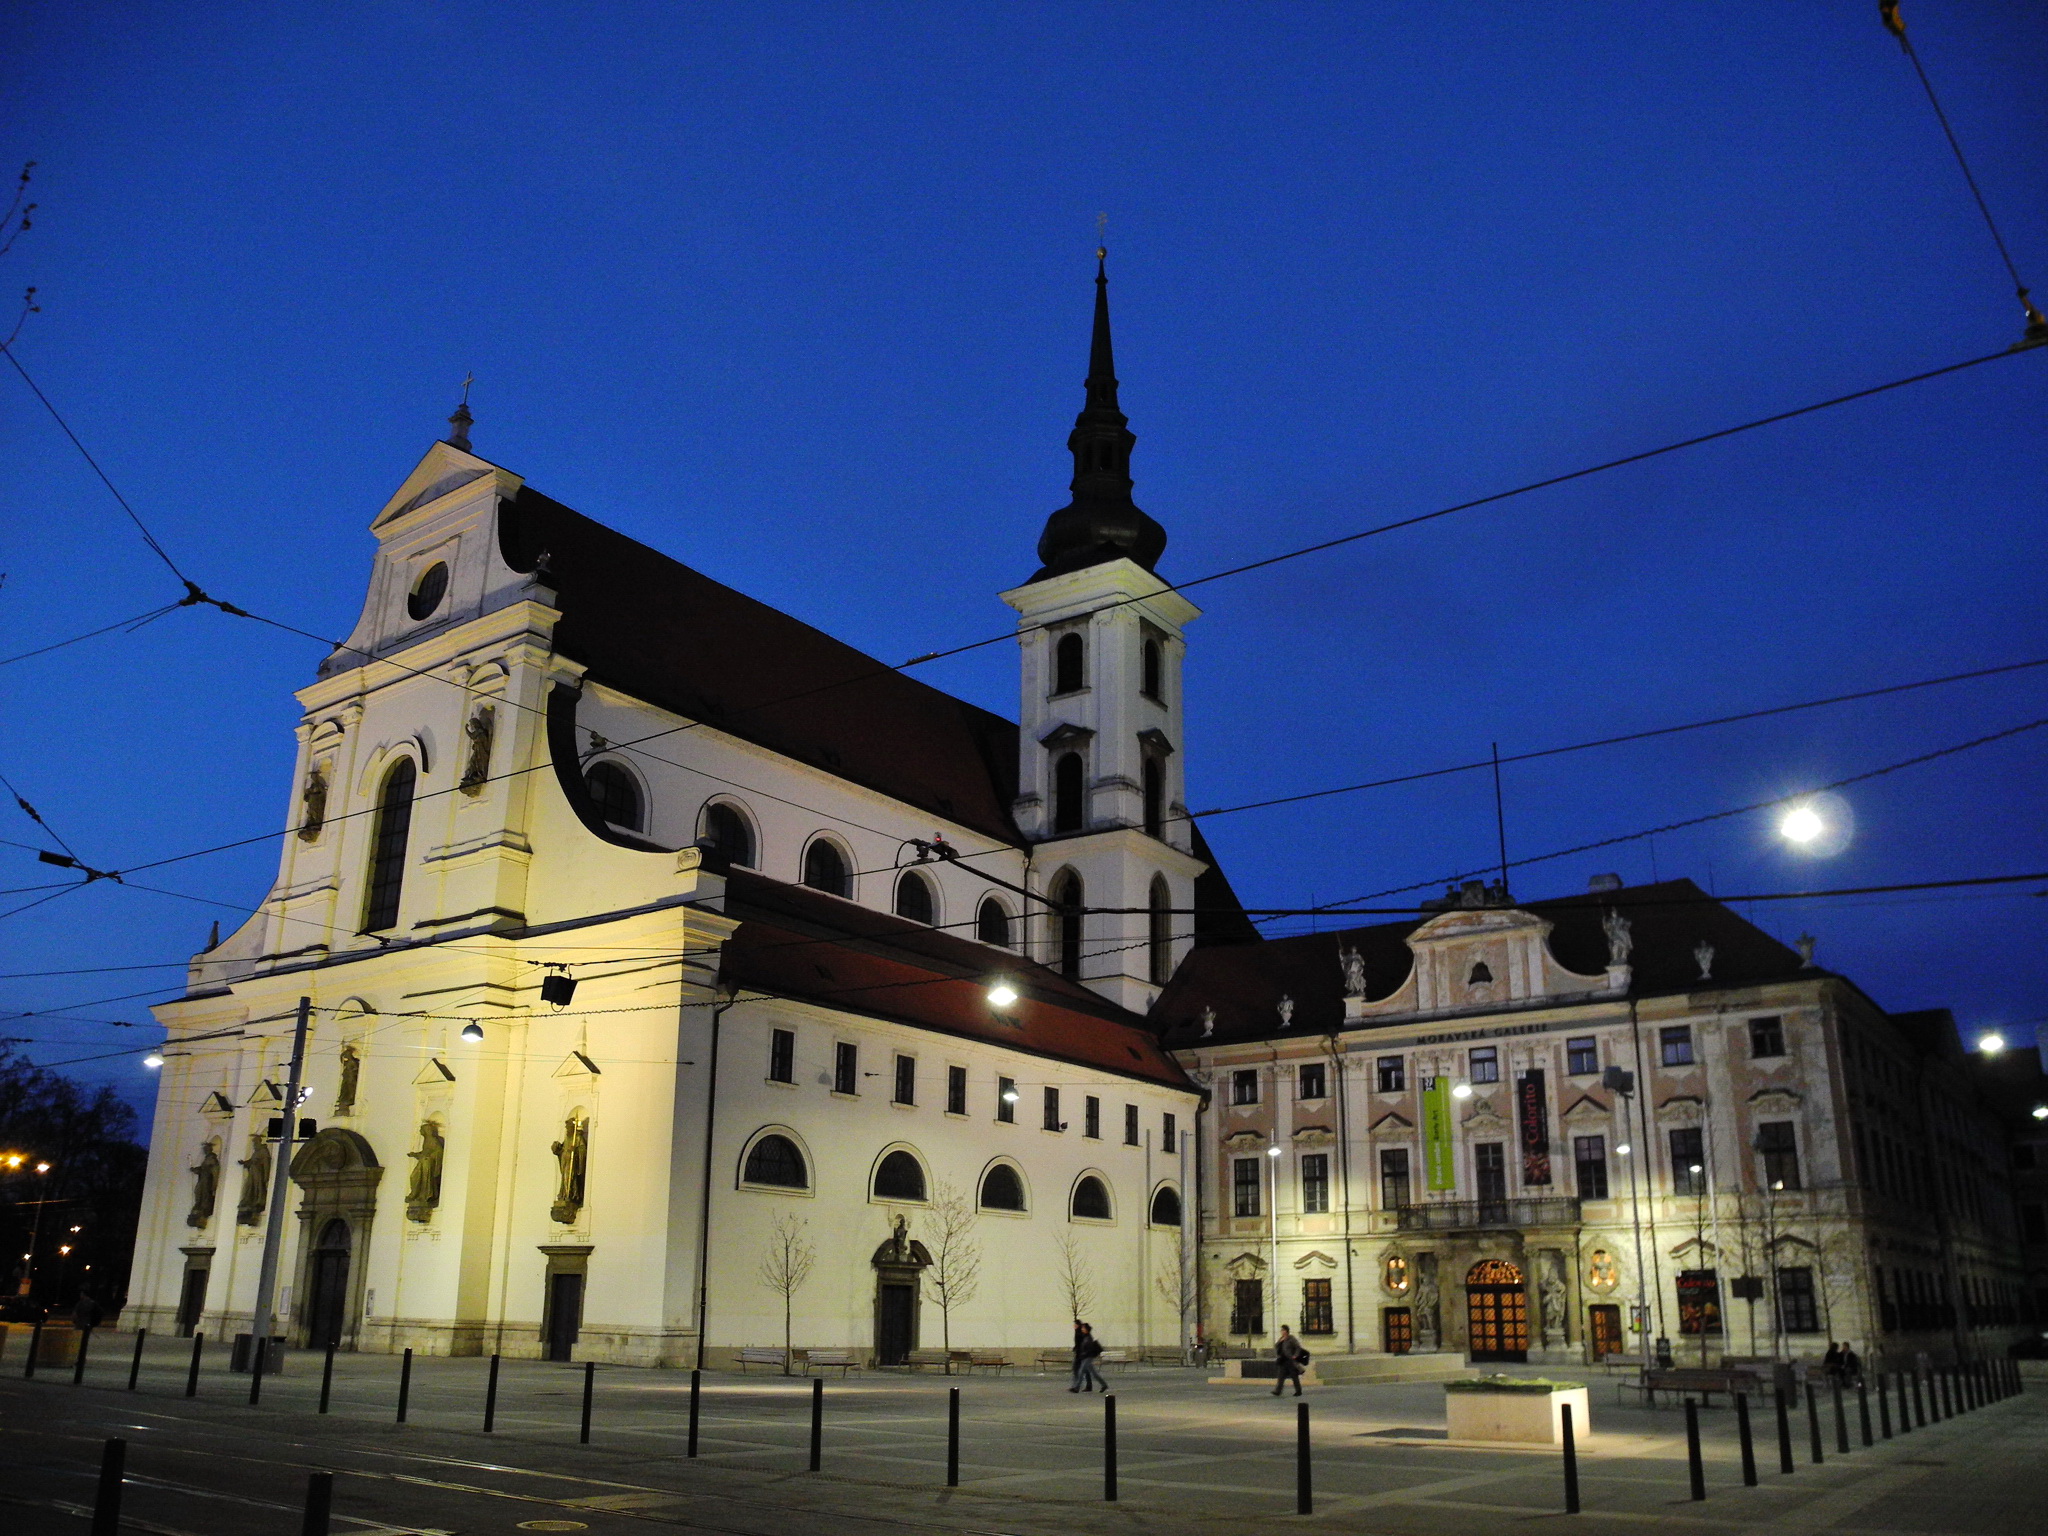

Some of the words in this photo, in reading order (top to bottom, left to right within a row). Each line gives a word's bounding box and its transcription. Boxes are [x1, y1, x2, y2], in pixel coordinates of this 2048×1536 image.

[1416, 1028, 1485, 1044] MORAVSKÁ
[1494, 1023, 1548, 1037] GALERIE
[1522, 1083, 1540, 1144] Colorito
